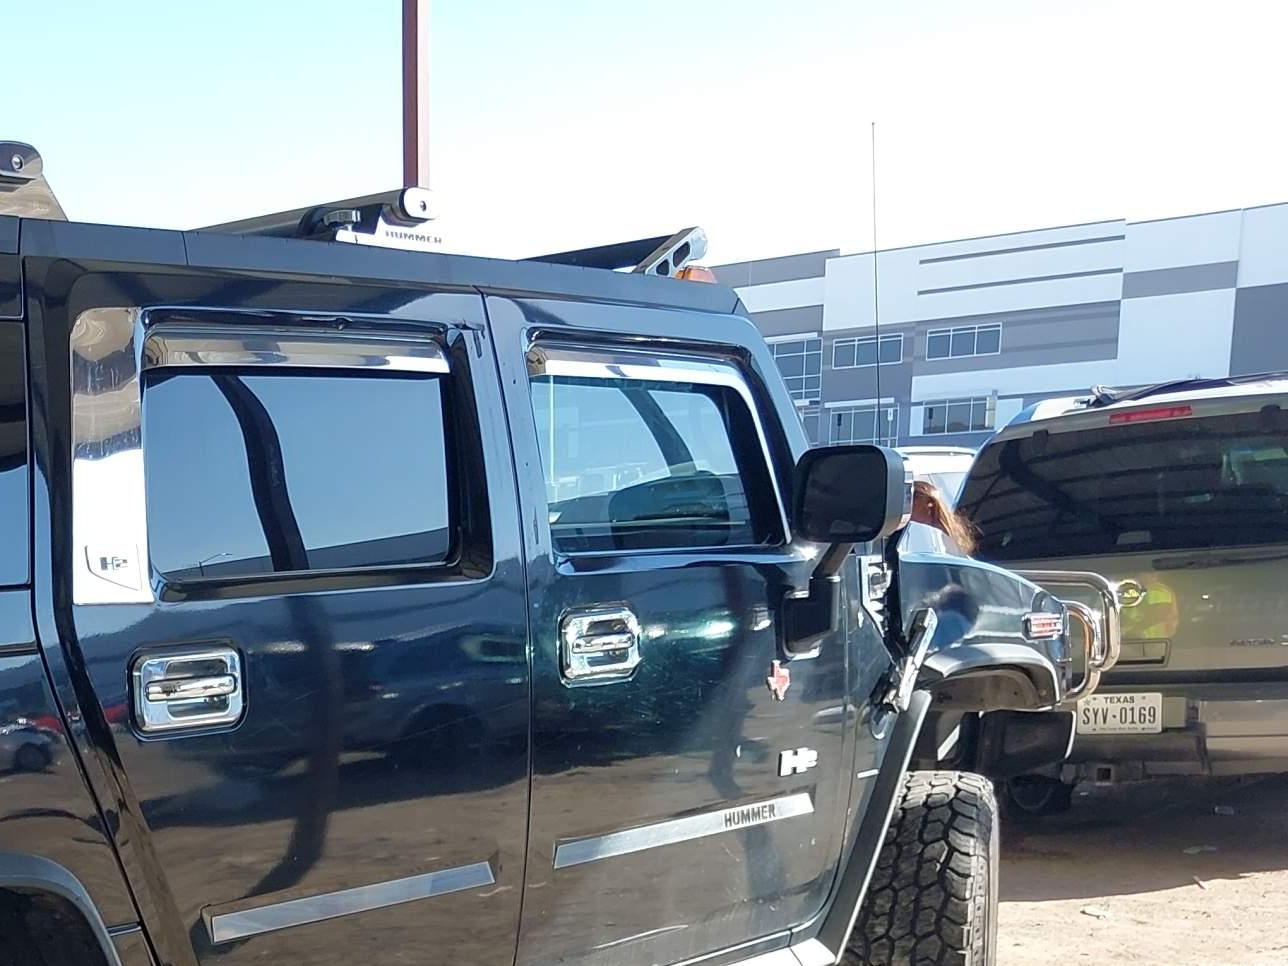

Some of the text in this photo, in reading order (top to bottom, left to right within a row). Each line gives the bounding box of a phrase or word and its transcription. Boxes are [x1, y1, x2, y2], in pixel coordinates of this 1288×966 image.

[385, 230, 443, 244] HUMMER
[1103, 695, 1135, 704] TEXAS
[777, 747, 818, 777] H2
[723, 803, 777, 828] HUMMER
